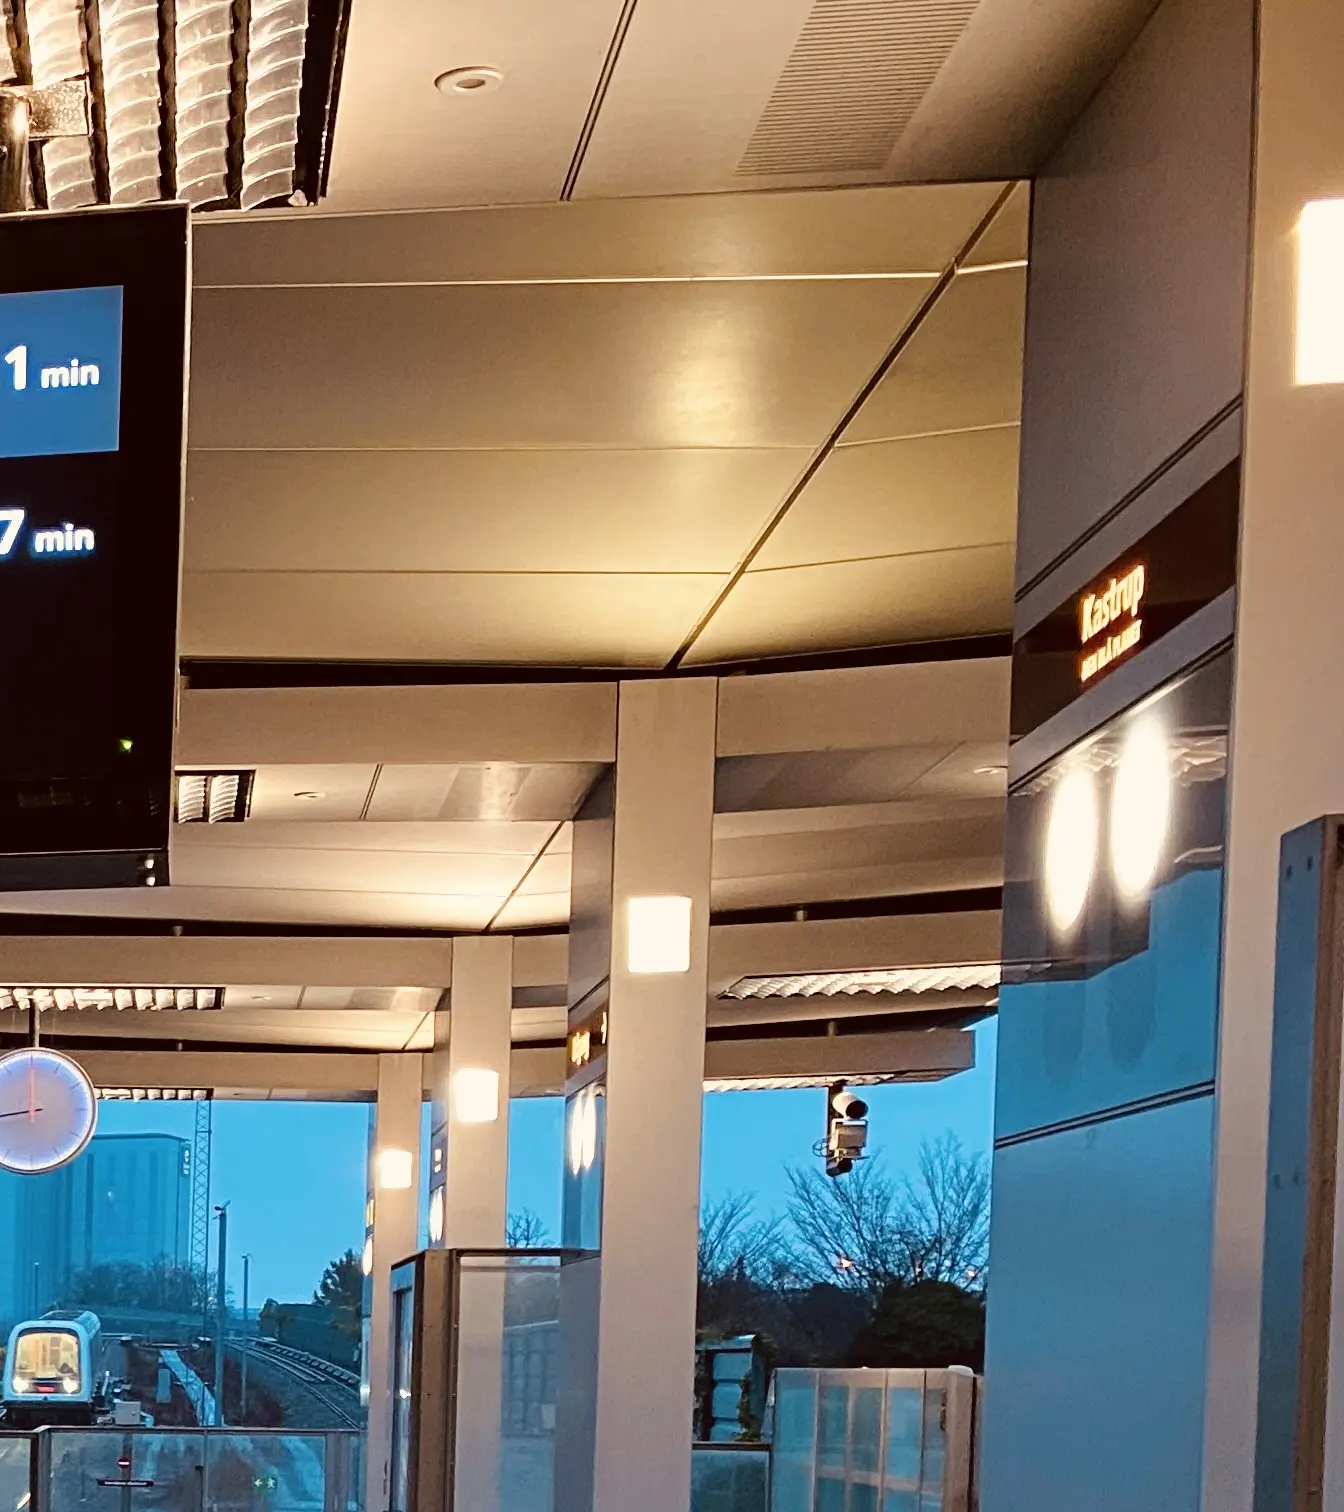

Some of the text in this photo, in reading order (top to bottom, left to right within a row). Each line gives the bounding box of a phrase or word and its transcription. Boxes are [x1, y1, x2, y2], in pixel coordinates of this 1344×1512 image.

[4, 345, 100, 390] 1 min
[34, 522, 95, 553] min
[1080, 564, 1145, 645] Kastrup
